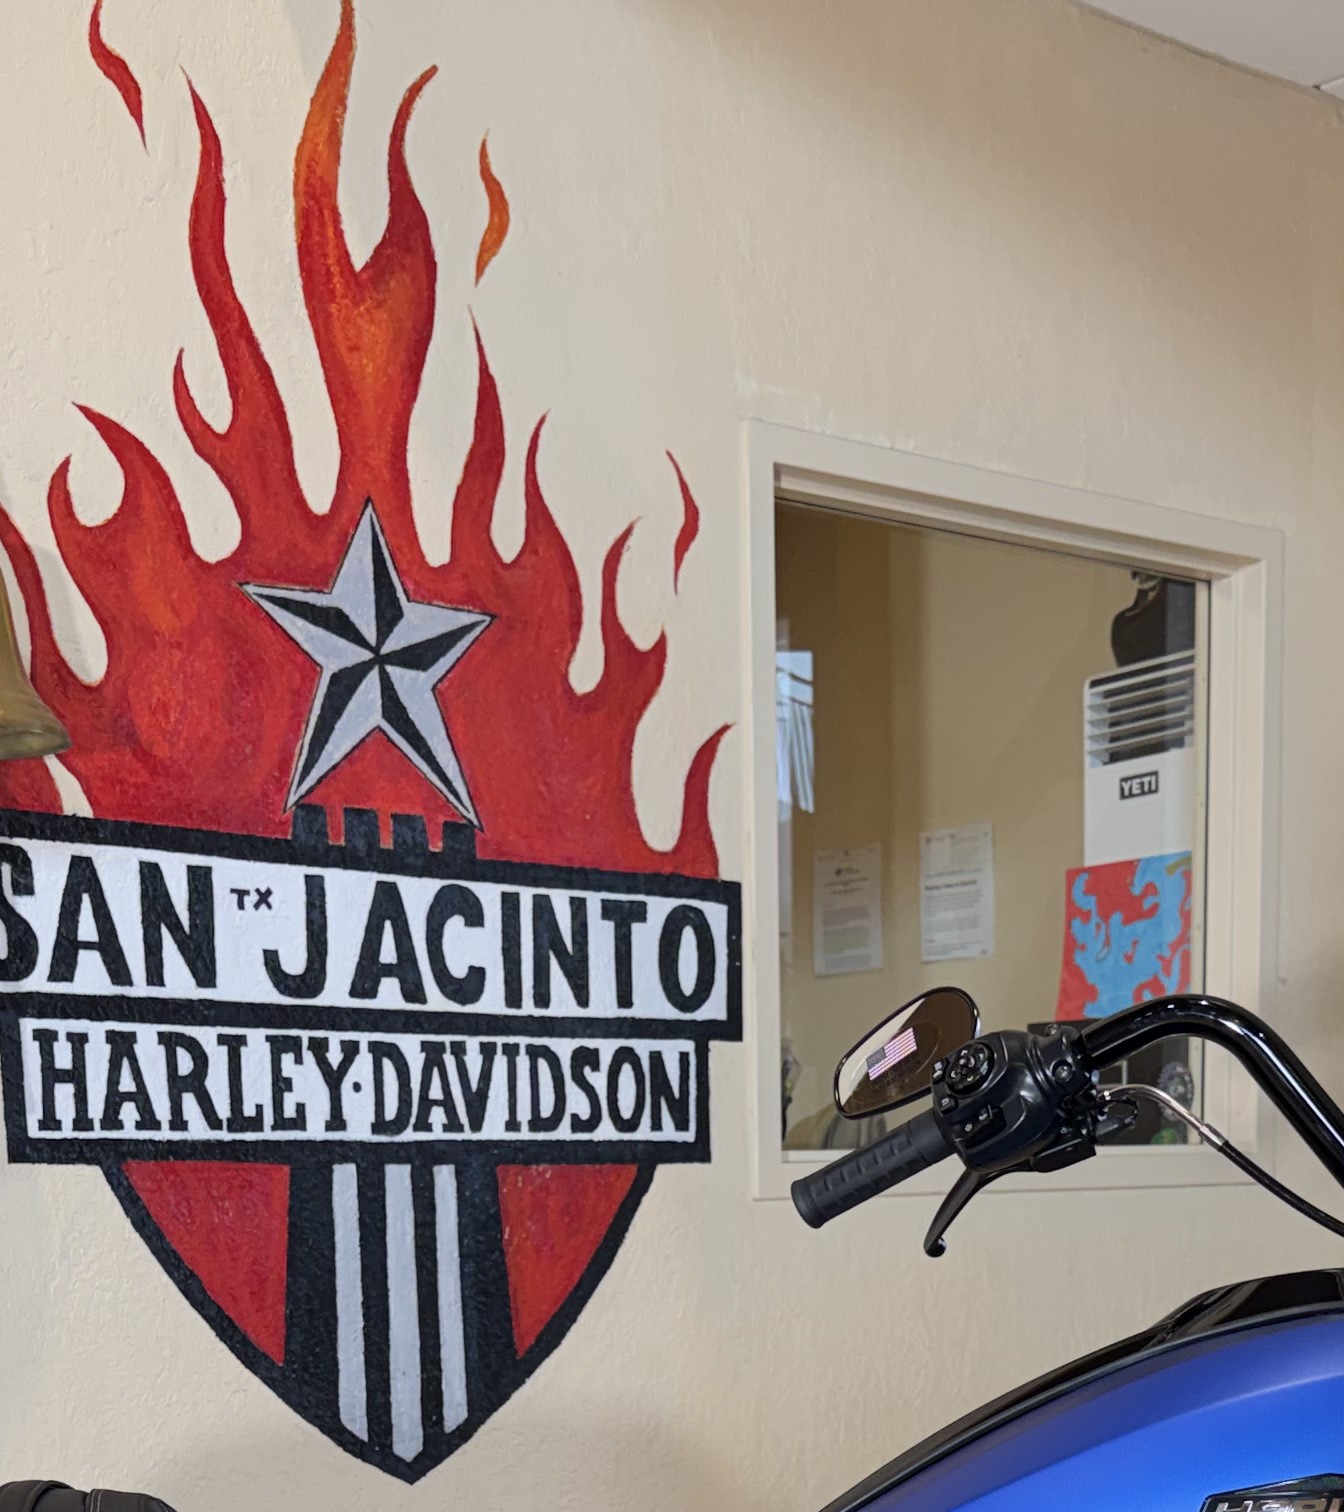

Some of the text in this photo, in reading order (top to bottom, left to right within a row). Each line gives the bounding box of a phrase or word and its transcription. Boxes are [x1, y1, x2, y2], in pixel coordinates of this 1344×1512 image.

[1121, 775, 1157, 797] YETI
[230, 887, 273, 911] TX
[263, 874, 717, 1014] JACINTO
